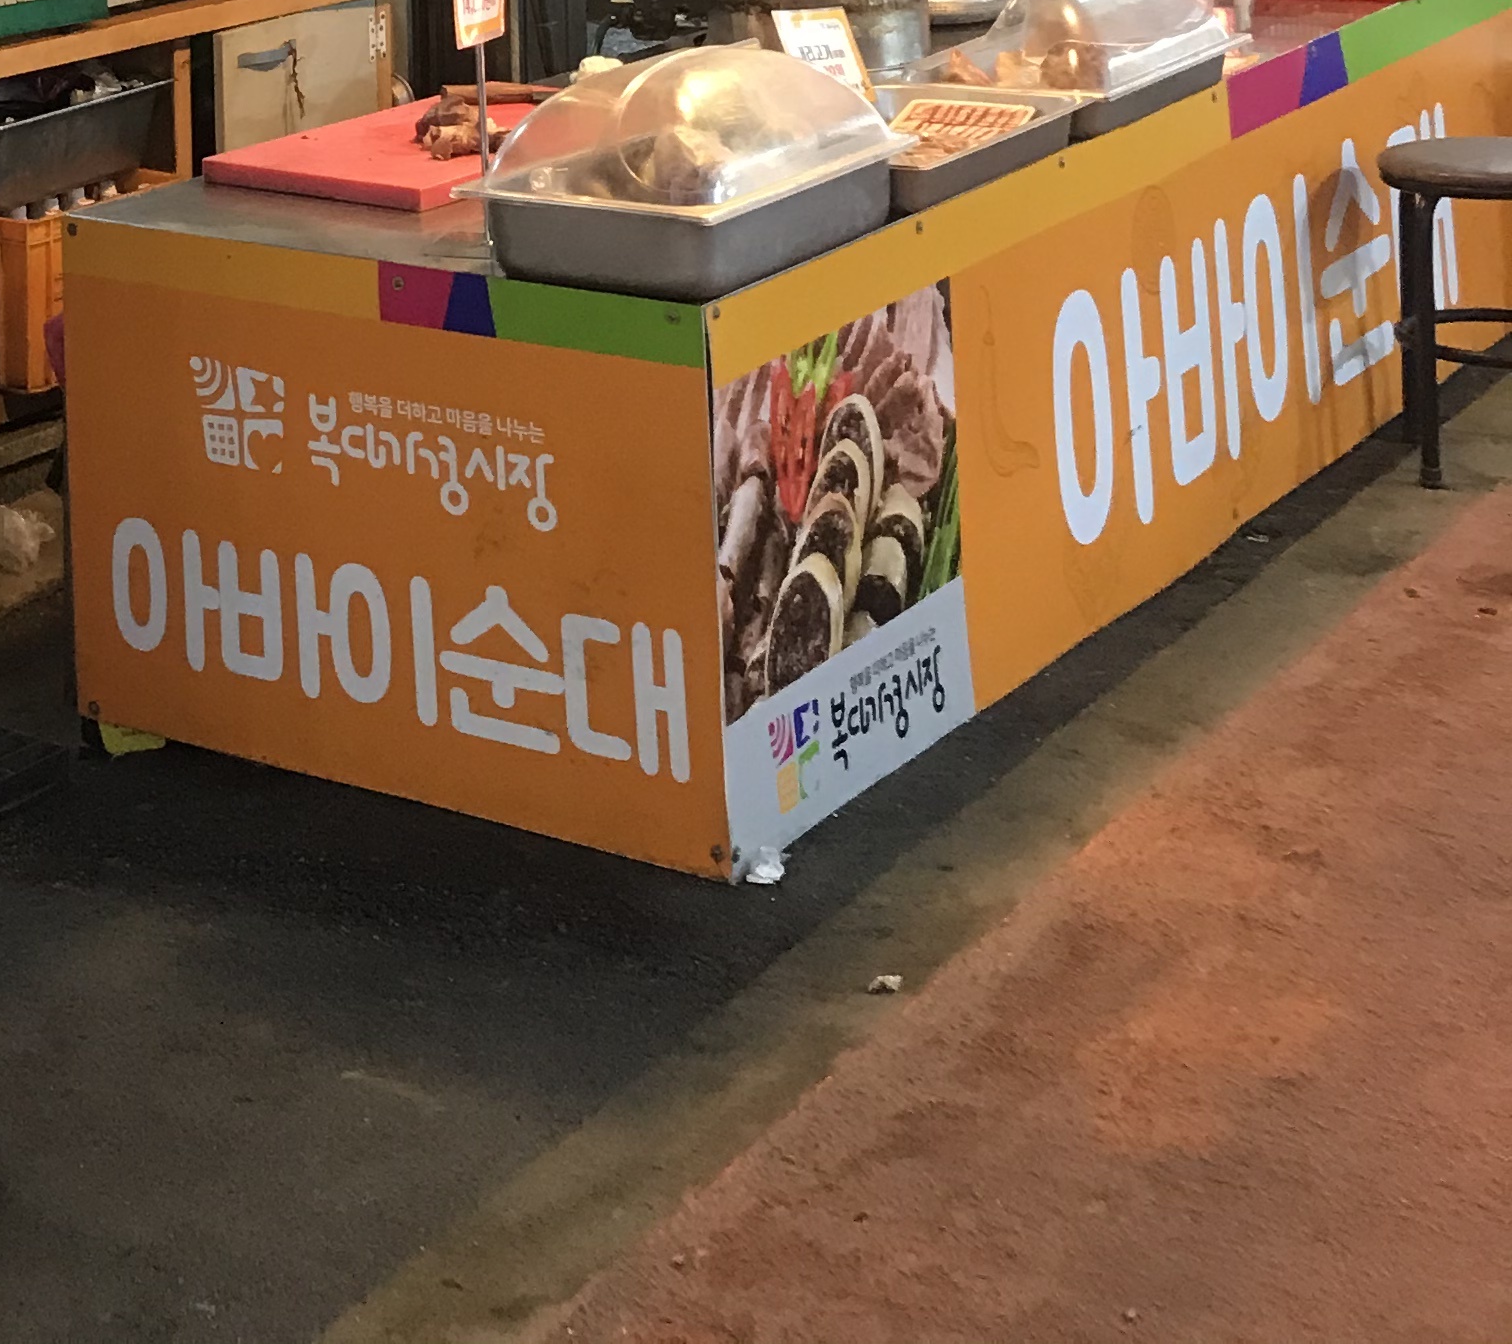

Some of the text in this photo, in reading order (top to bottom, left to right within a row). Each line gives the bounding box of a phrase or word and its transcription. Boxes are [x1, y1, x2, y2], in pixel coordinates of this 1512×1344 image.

[308, 392, 558, 531] 복대가경시장
[347, 390, 546, 445] 행복을 더하고 마음을 나누는
[112, 516, 690, 783] 아바이순대
[830, 644, 946, 771] 복대가경시장
